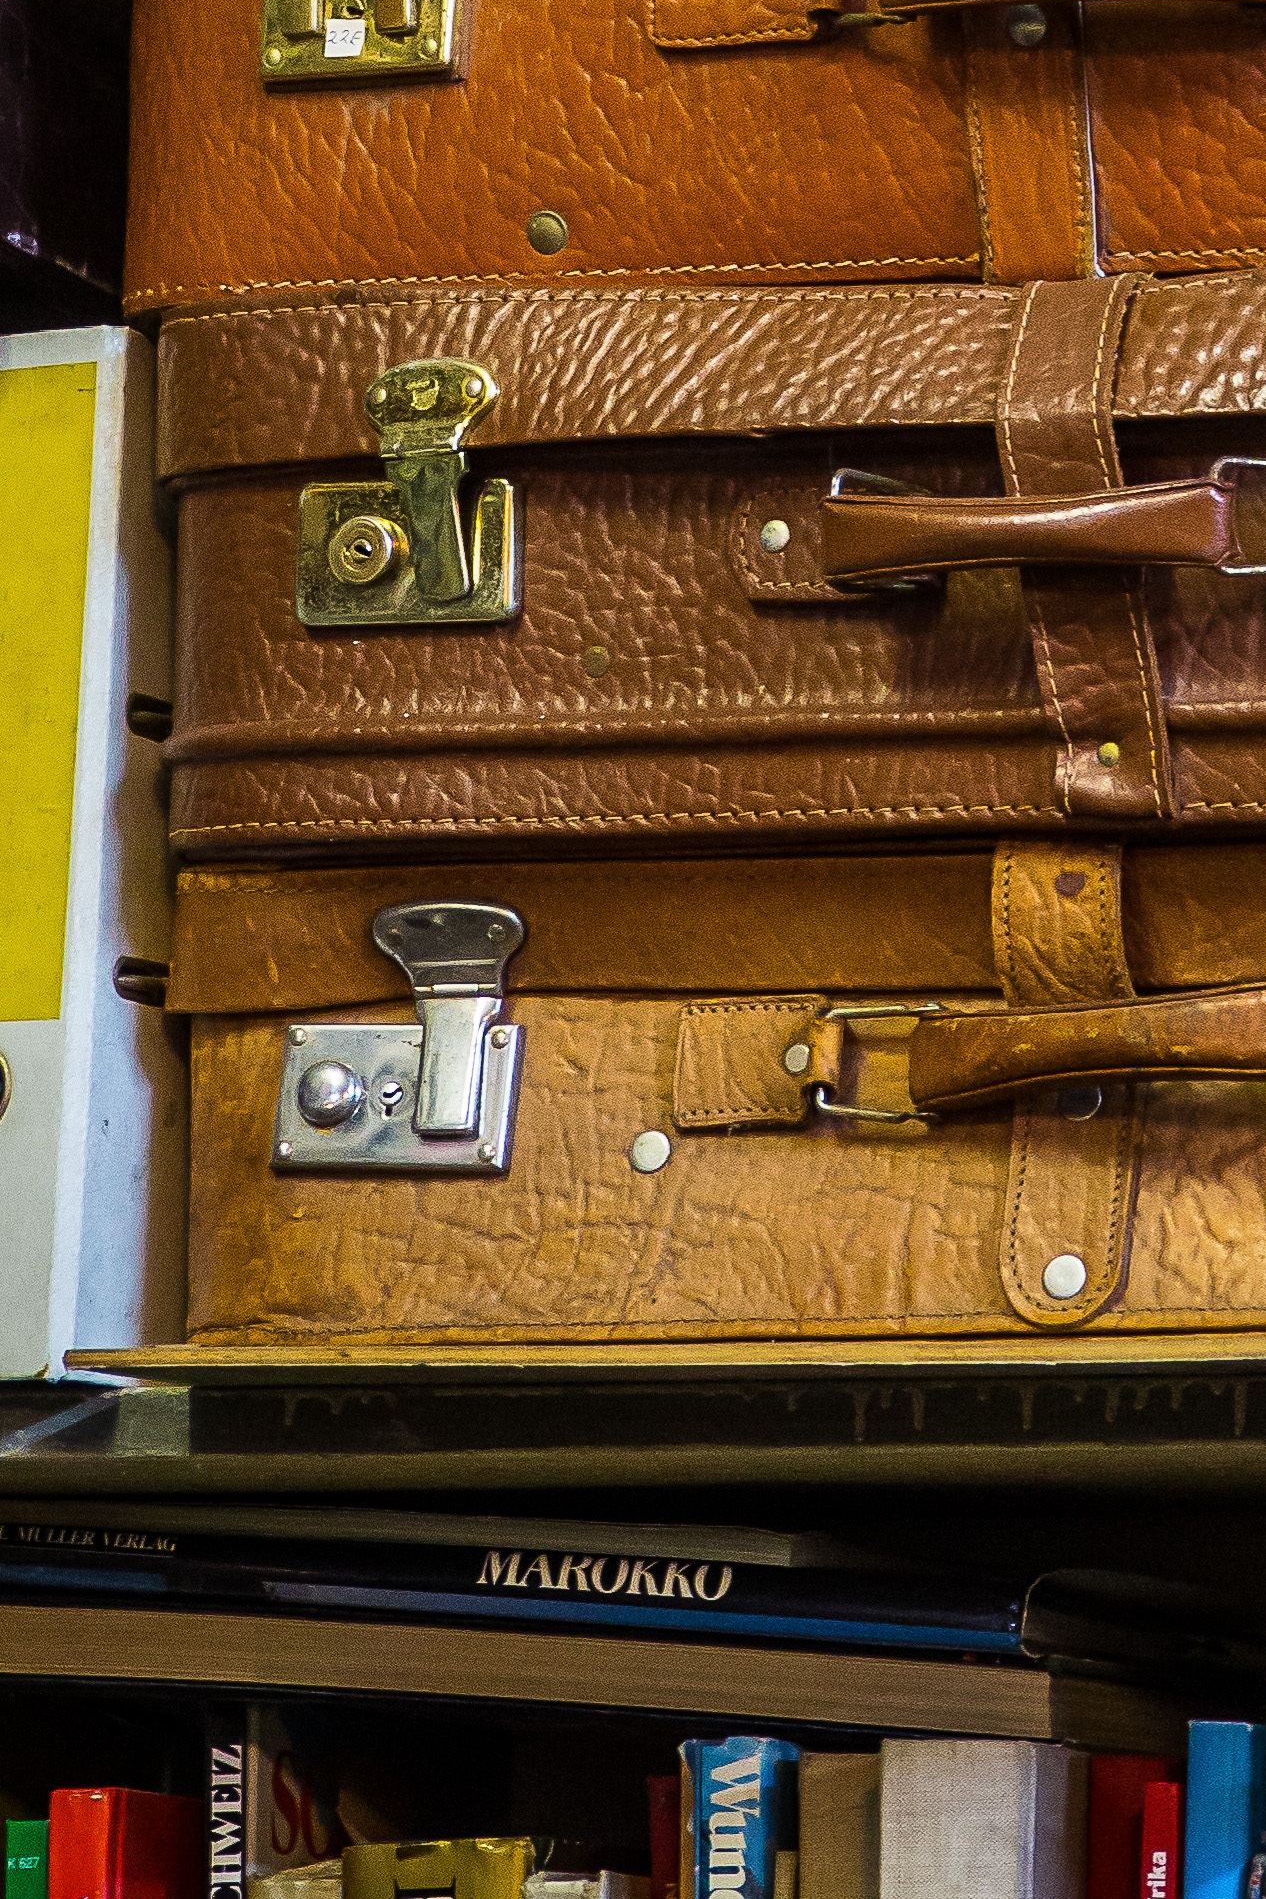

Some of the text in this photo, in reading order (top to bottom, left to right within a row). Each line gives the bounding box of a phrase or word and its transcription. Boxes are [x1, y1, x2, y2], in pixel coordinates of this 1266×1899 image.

[475, 1550, 733, 1602] MAROKKO
[708, 1753, 762, 1899] Wun
[1147, 1850, 1168, 1899] rika
